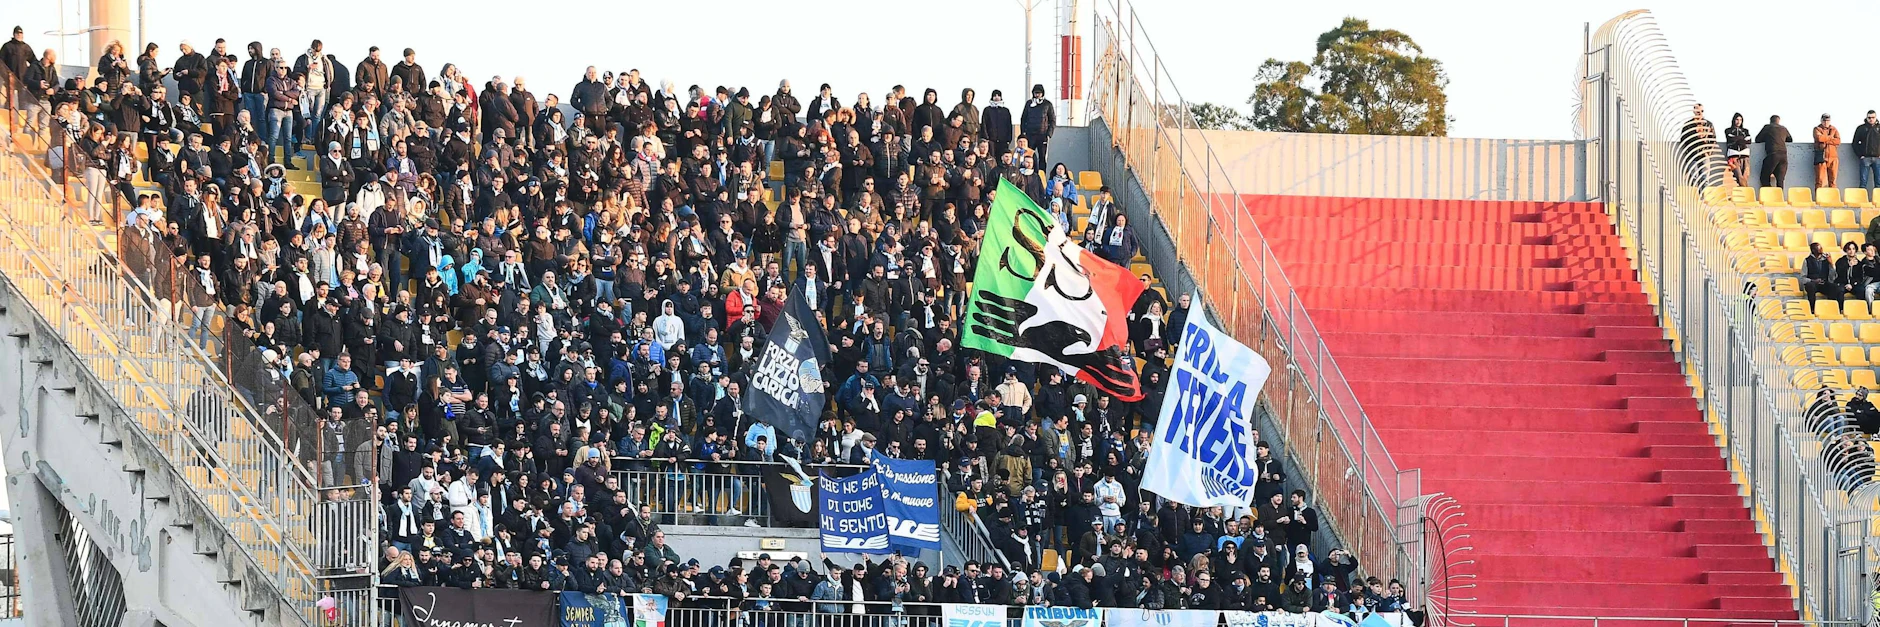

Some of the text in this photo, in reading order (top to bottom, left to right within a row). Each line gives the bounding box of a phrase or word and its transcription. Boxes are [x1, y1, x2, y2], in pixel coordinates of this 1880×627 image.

[766, 340, 800, 374] FORZA
[758, 354, 800, 390] LAZIO
[752, 372, 799, 409] CARICA
[820, 472, 878, 494] CHE NE SAI
[893, 471, 936, 484] passione
[828, 496, 873, 513] DI COME
[902, 495, 934, 508] muove
[840, 512, 886, 534] SENTO
[565, 606, 596, 621] SEMPER
[1027, 606, 1099, 620] TRIBUNA
